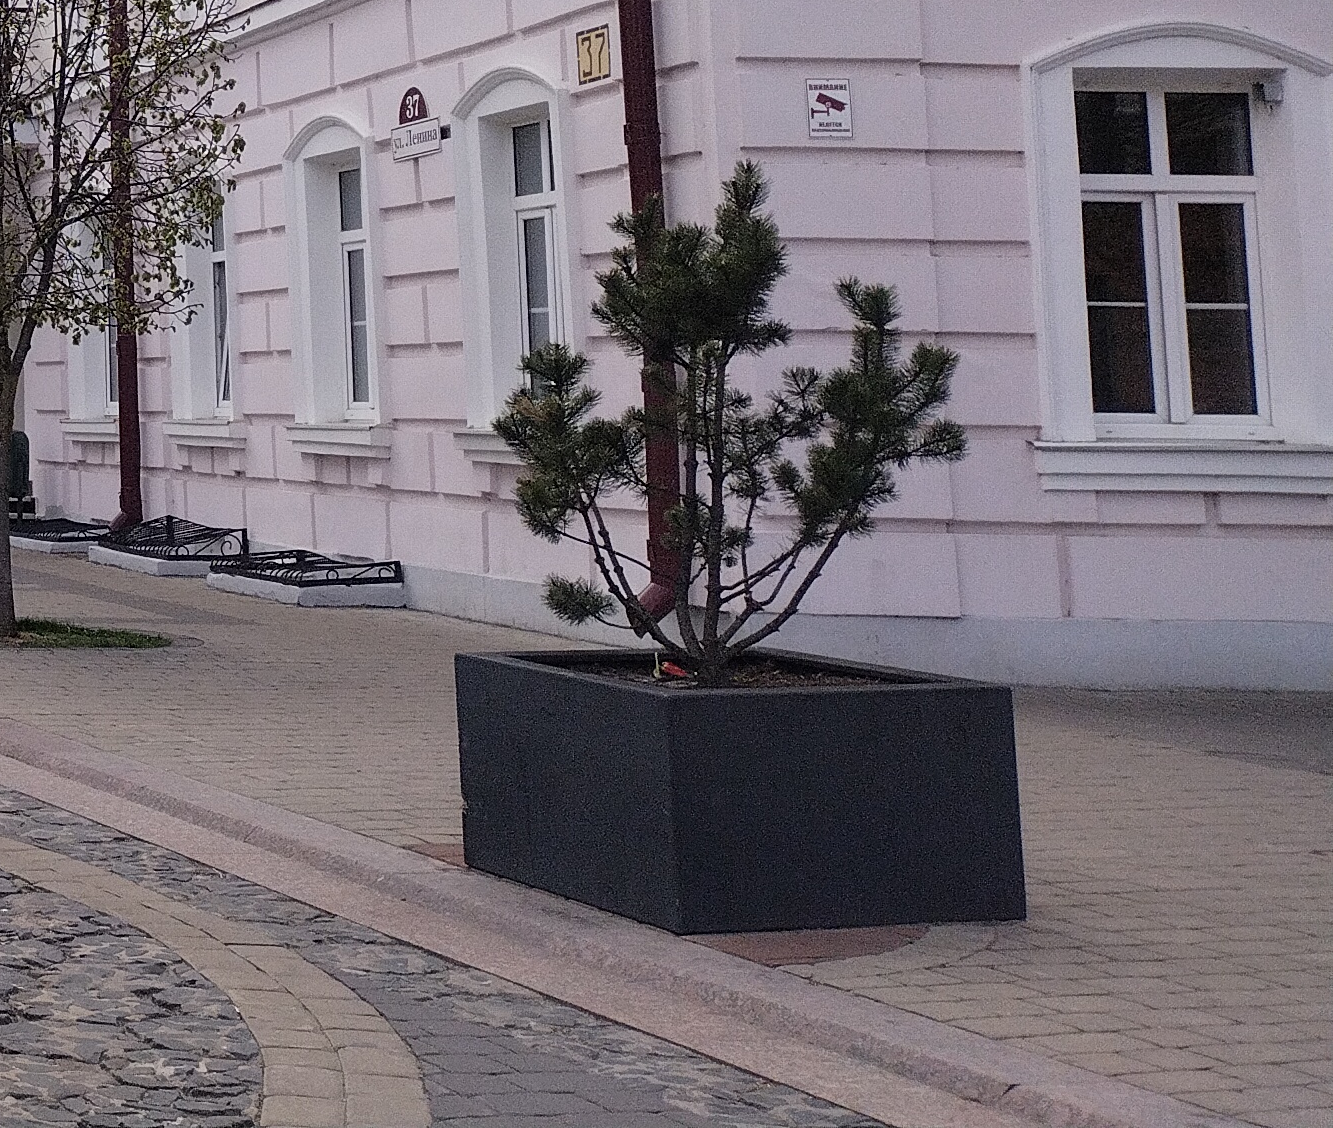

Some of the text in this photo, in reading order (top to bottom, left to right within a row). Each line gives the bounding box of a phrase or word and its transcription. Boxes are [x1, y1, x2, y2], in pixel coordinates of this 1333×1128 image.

[580, 31, 606, 79] 37
[405, 93, 420, 119] 37
[393, 128, 438, 154] ул. Ленина
